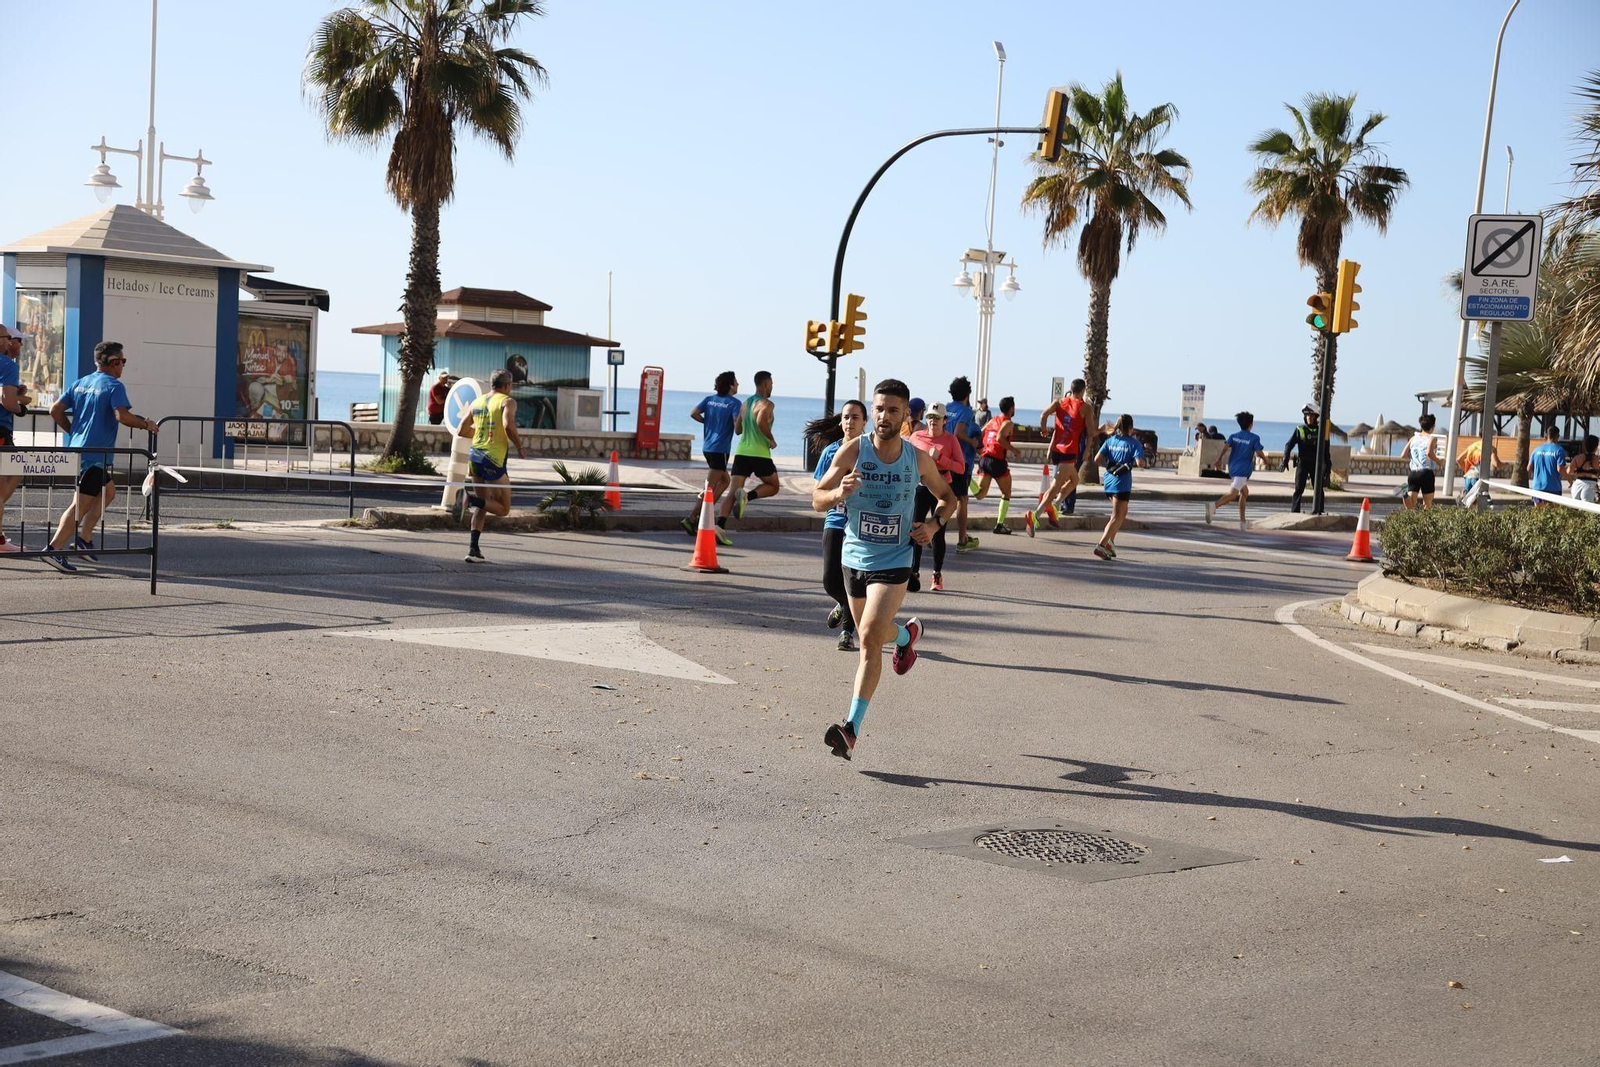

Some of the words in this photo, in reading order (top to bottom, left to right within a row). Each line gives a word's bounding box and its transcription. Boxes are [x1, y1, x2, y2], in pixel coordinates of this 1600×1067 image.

[107, 277, 149, 292] Helados
[159, 282, 174, 295] Ice
[177, 283, 215, 298] Creams
[1467, 303, 1528, 311] ESTACIONAMIENTO
[280, 400, 291, 410] 10
[10, 454, 41, 464] POLA
[43, 455, 69, 464] LOCAL
[861, 471, 901, 485] nerja
[864, 523, 896, 535] 1647
